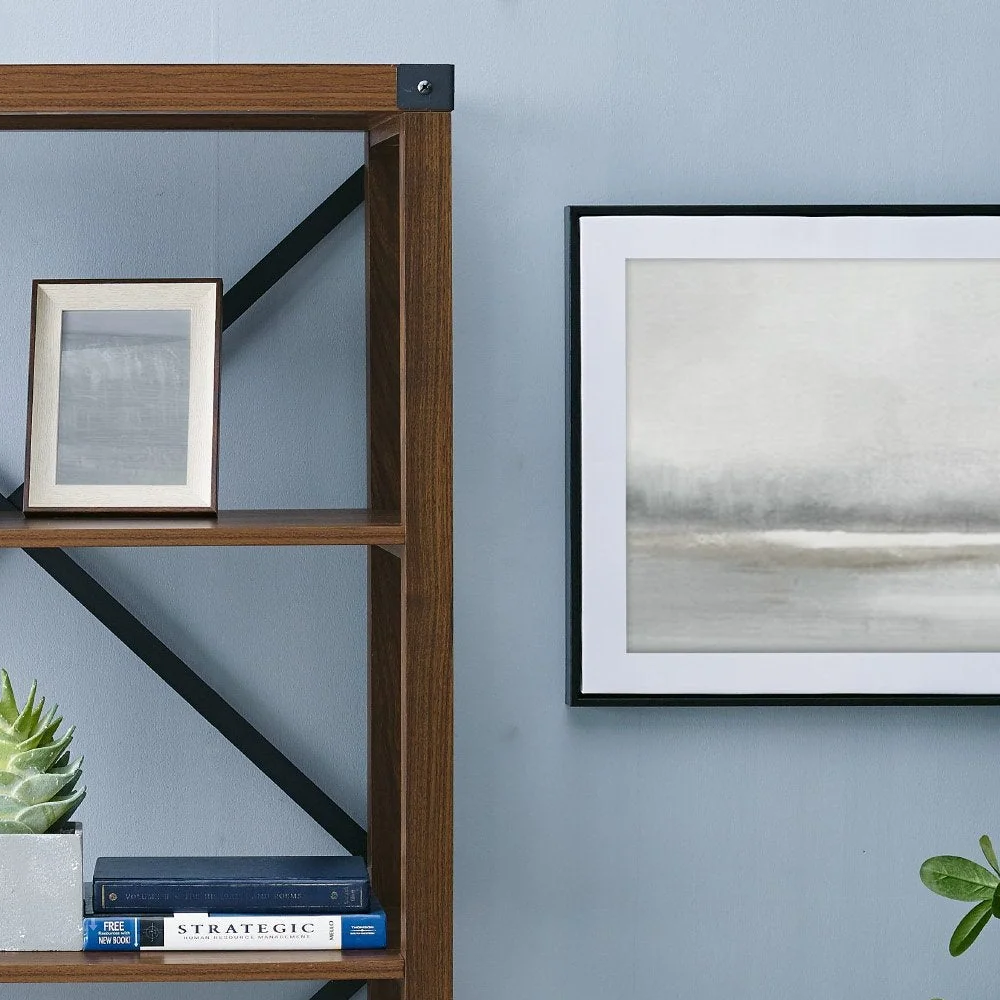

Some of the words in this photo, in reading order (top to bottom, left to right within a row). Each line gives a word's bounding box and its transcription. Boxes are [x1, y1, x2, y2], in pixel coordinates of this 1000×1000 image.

[103, 921, 125, 931] FREE
[177, 923, 315, 935] STRATEGIC
[98, 936, 112, 945] NEW
[112, 936, 131, 945] BOOK!
